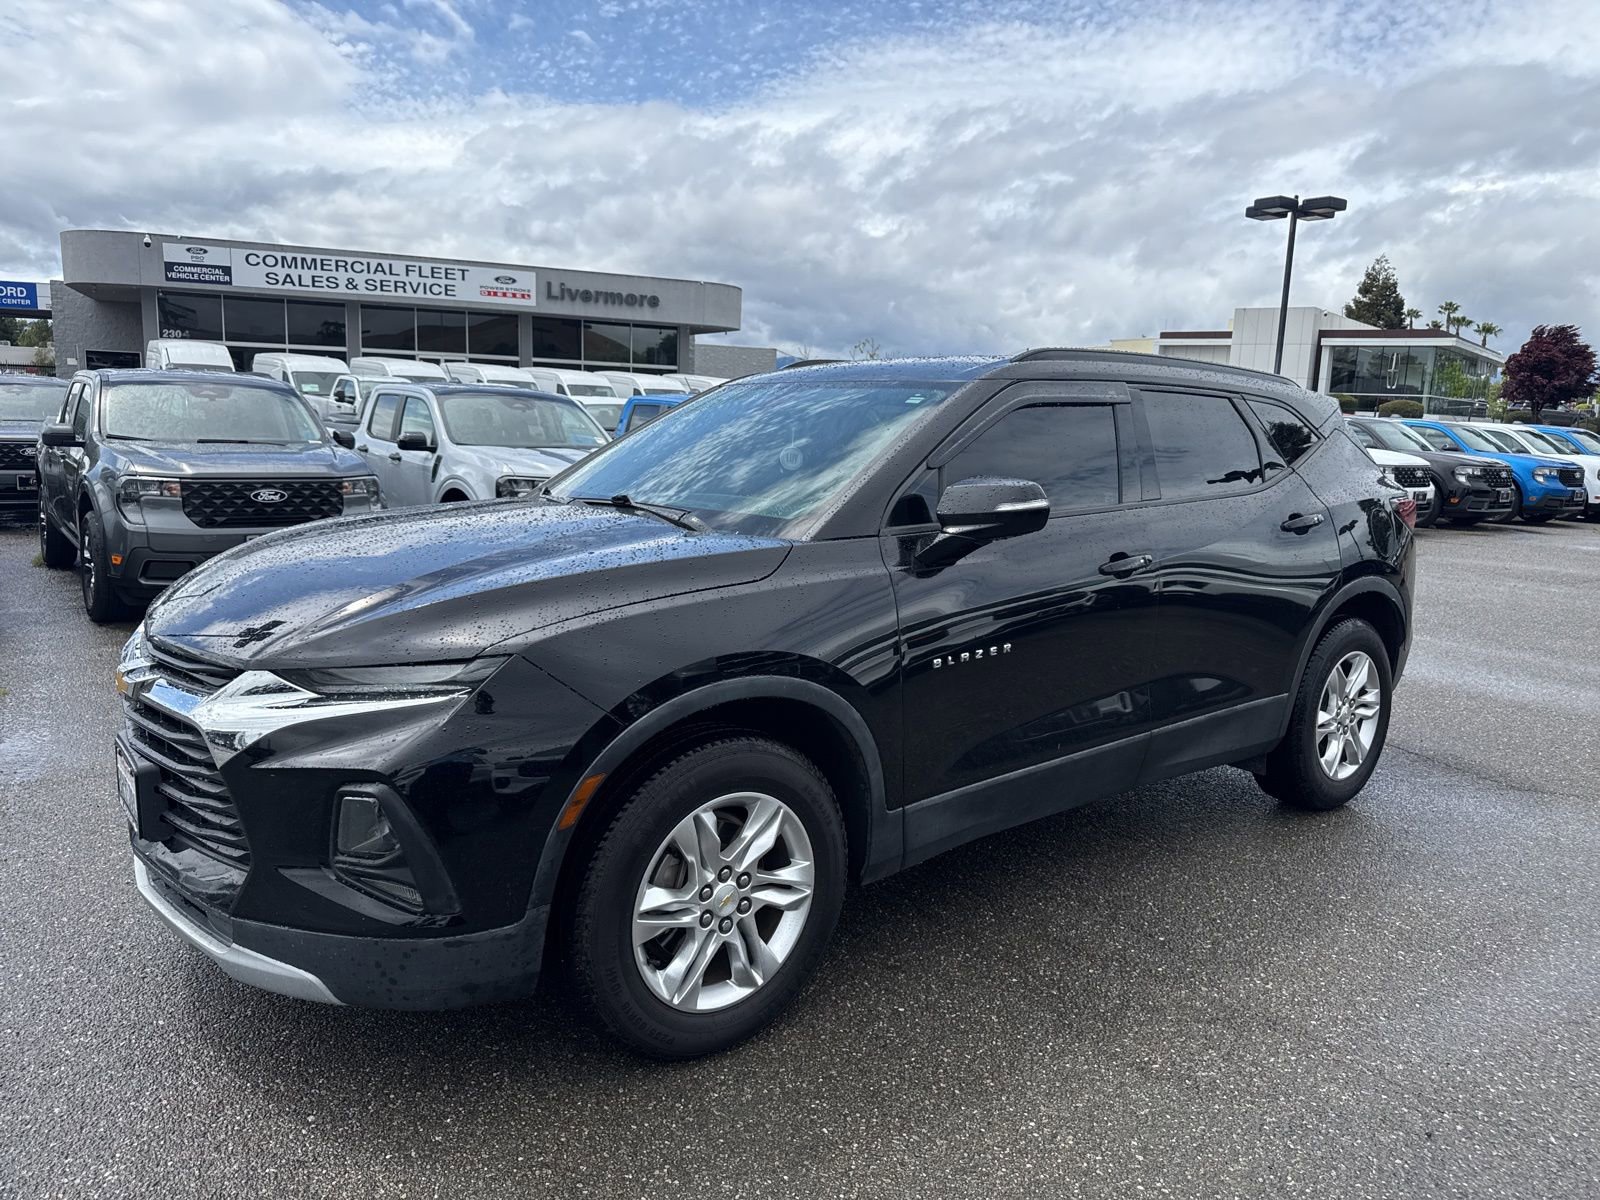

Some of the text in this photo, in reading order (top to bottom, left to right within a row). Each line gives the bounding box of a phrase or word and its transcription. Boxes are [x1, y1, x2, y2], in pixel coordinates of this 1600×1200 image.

[167, 271, 230, 282] VEHICLE CENTER
[173, 265, 225, 275] COMMERCIAL
[245, 253, 470, 281] COMMERCIAL FLEET
[265, 272, 457, 297] SALES & SERVICE
[546, 281, 660, 308] Livermore
[933, 642, 1012, 669] BLAZER
